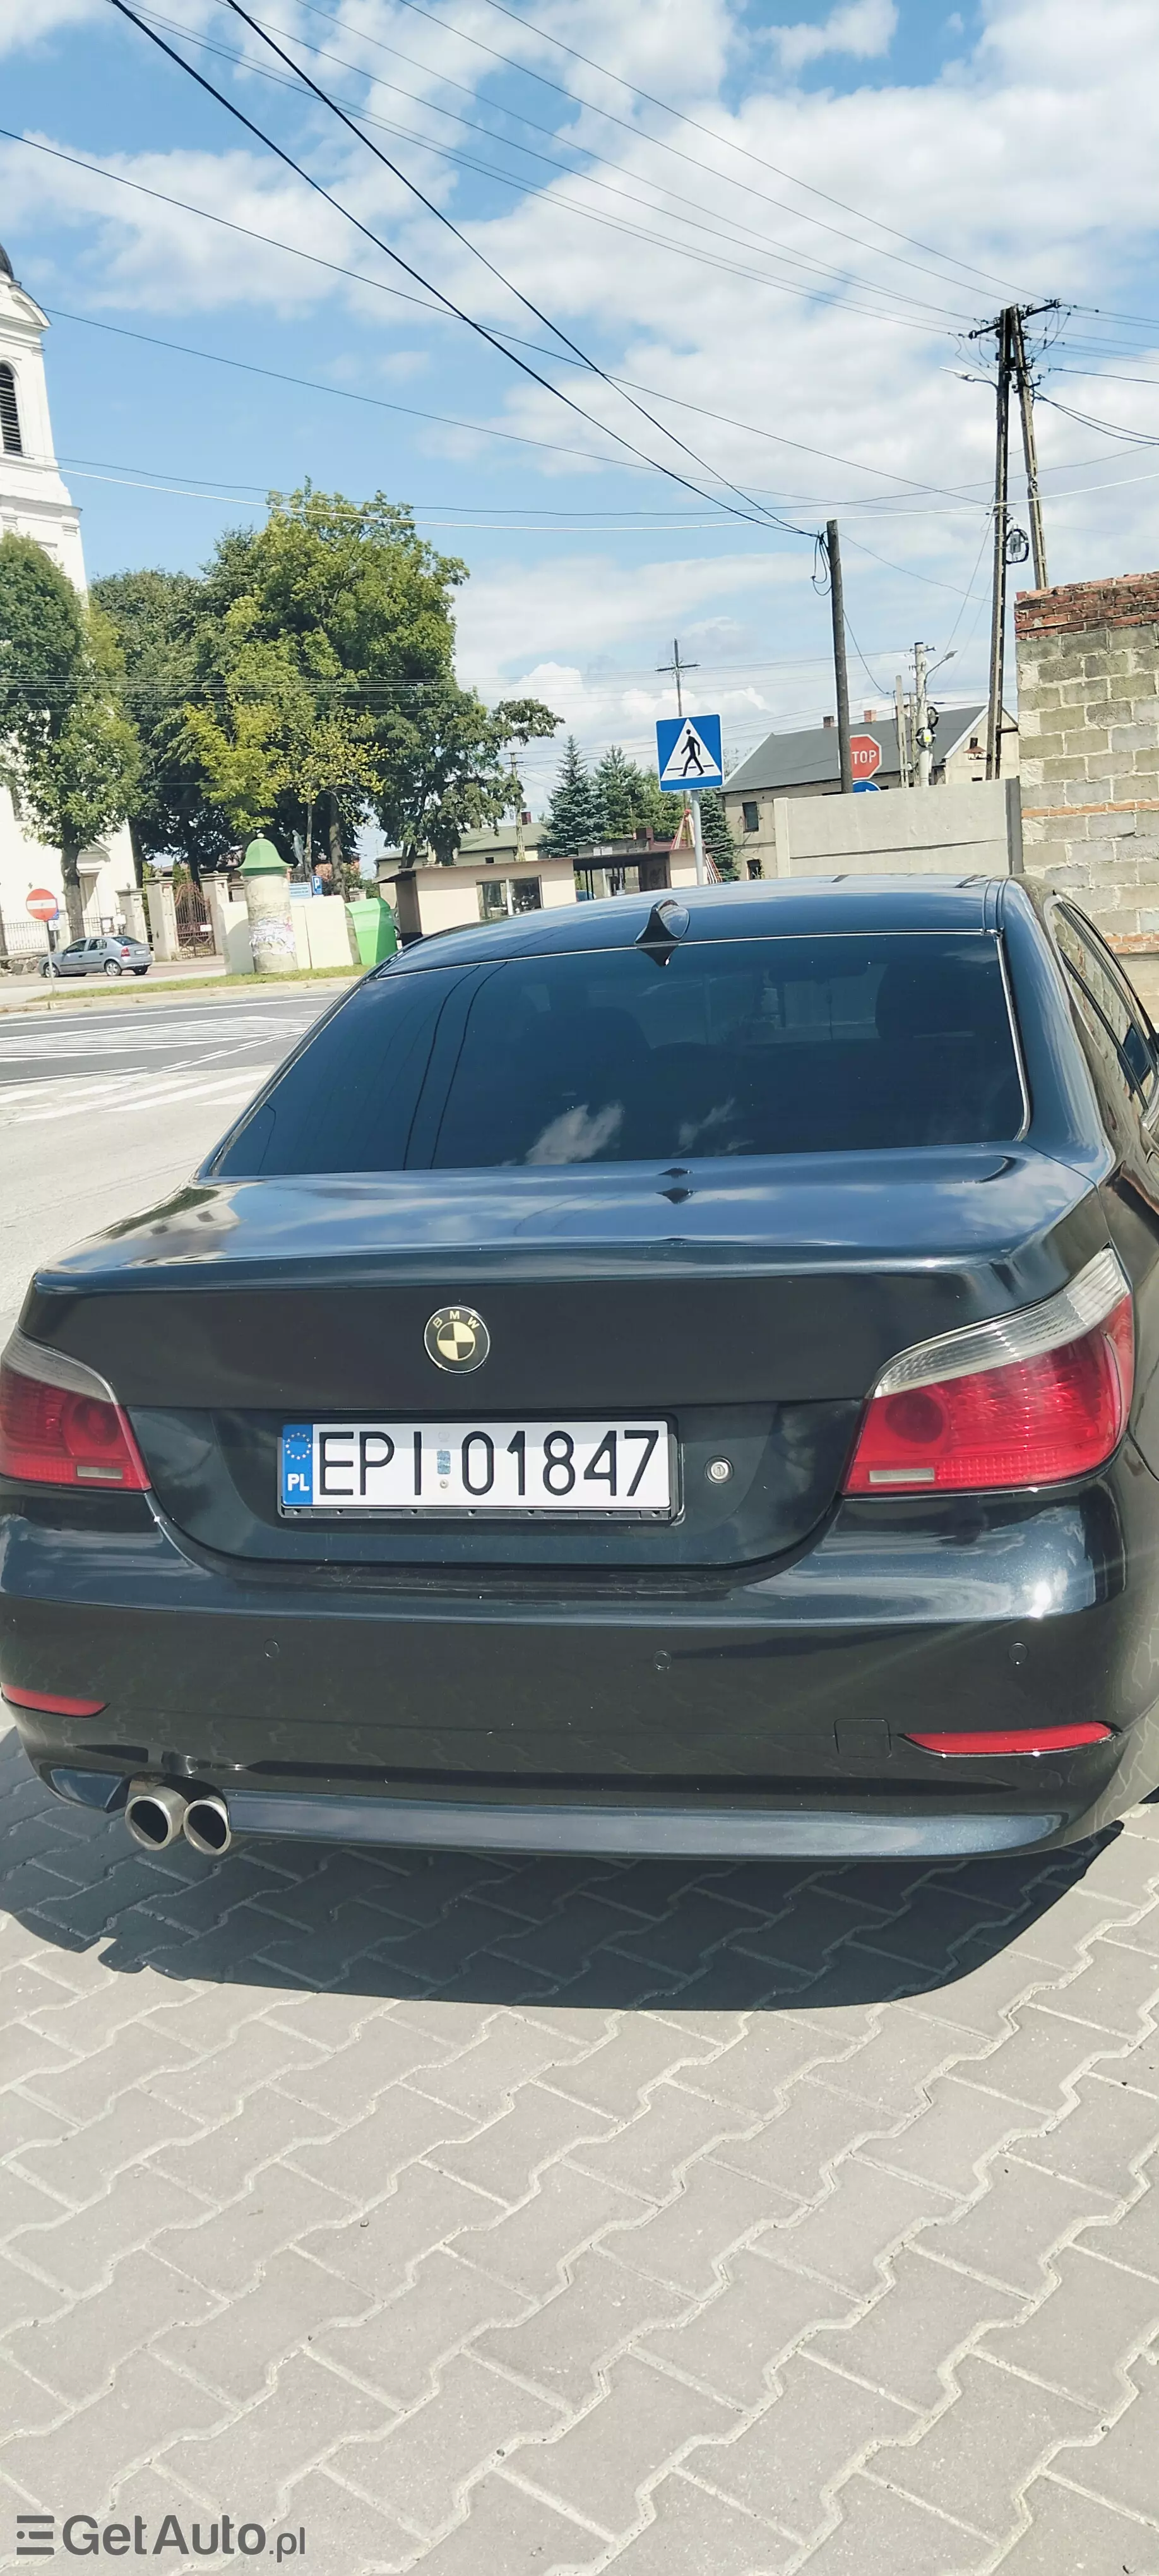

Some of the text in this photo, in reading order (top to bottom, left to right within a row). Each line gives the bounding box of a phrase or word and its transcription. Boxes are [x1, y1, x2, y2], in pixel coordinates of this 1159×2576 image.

[851, 749, 877, 765] TOP
[432, 1310, 480, 1329] BMW
[319, 1430, 659, 1497] EPI 01847
[287, 1473, 310, 1491] PL
